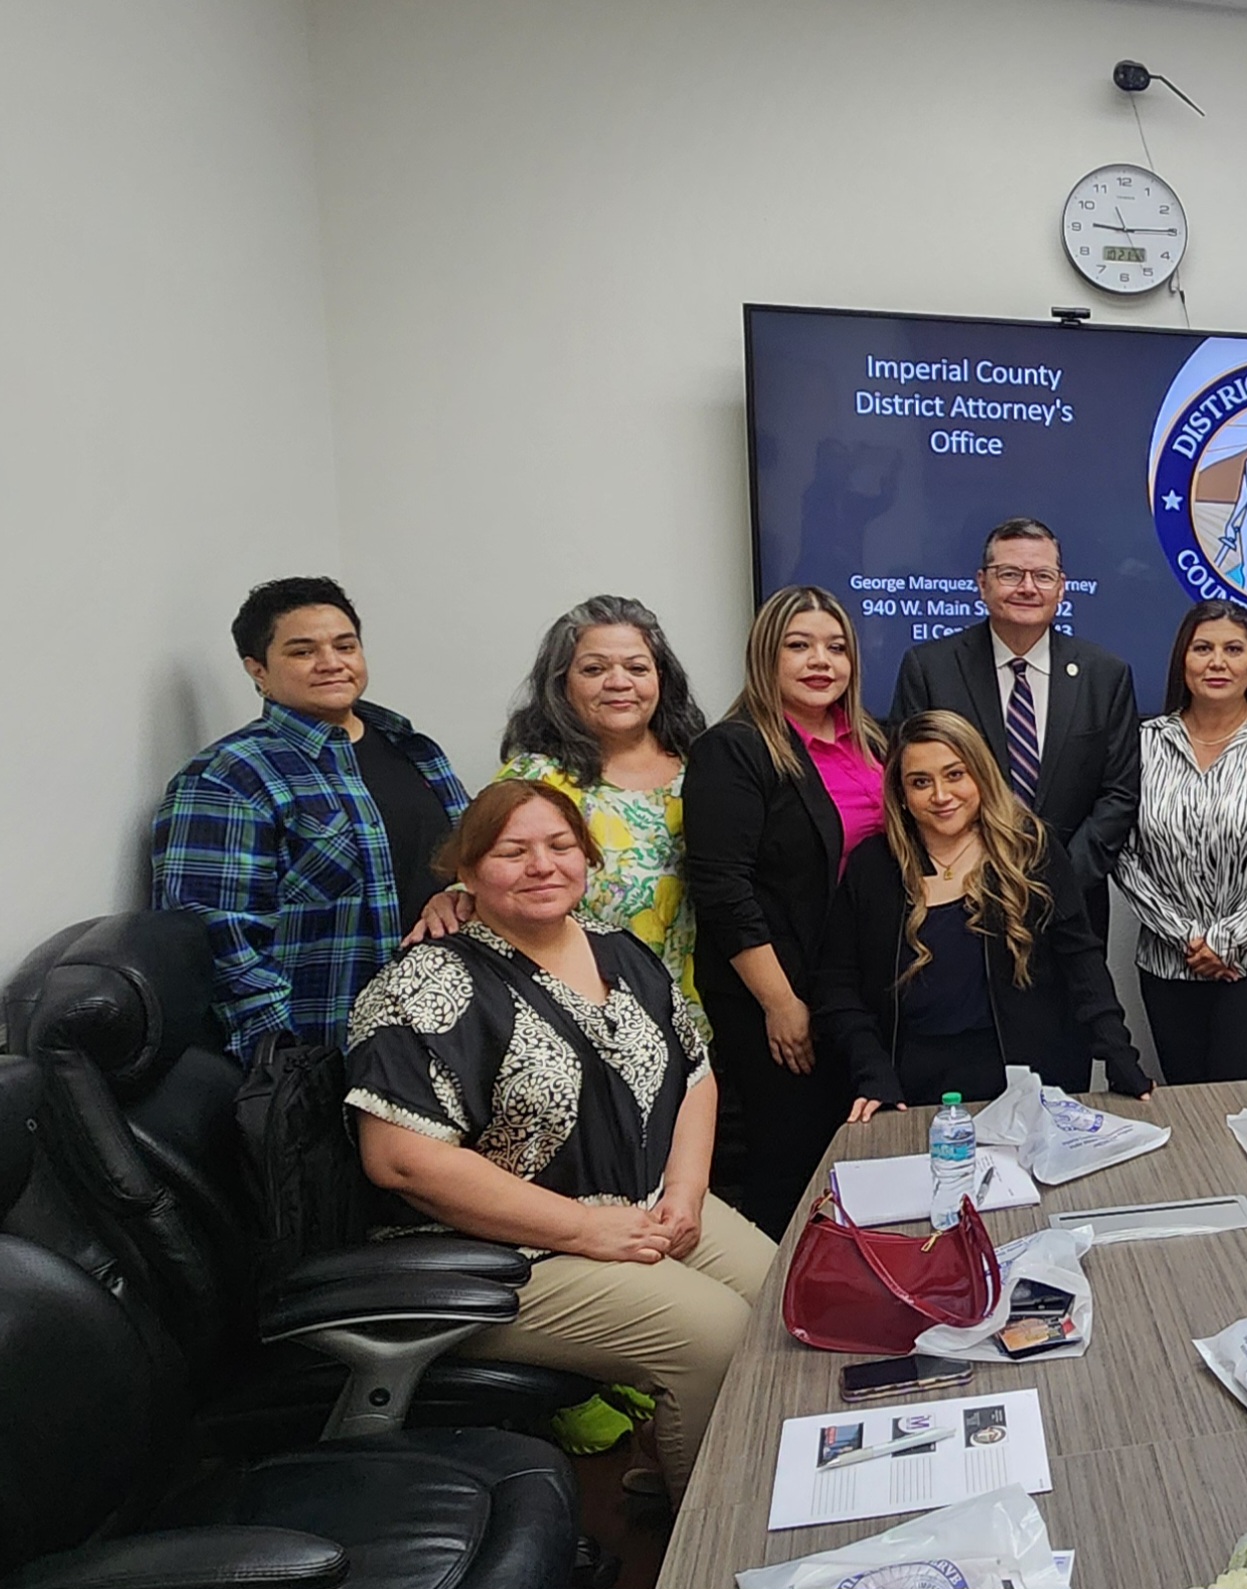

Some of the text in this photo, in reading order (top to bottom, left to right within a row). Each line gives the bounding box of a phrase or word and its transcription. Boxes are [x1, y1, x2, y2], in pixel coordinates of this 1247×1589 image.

[1116, 177, 1133, 187] 12
[1093, 184, 1107, 194] 11
[1144, 187, 1151, 197] 1
[1078, 200, 1095, 210] 10
[1159, 205, 1170, 215] 2
[1071, 222, 1082, 232] 9
[1079, 246, 1090, 256] 8
[1160, 251, 1170, 261] 4
[1096, 264, 1107, 274] 7
[1143, 267, 1153, 277] 5
[1119, 273, 1130, 282] 6
[867, 354, 1062, 391] Imperial County
[856, 391, 1074, 427] District Attorney's
[930, 430, 1003, 455] Office
[850, 575, 1098, 594] George Marquez, rney
[862, 600, 897, 616] 940
[900, 600, 923, 616] W.
[927, 600, 971, 616] Main
[912, 623, 928, 640] El
